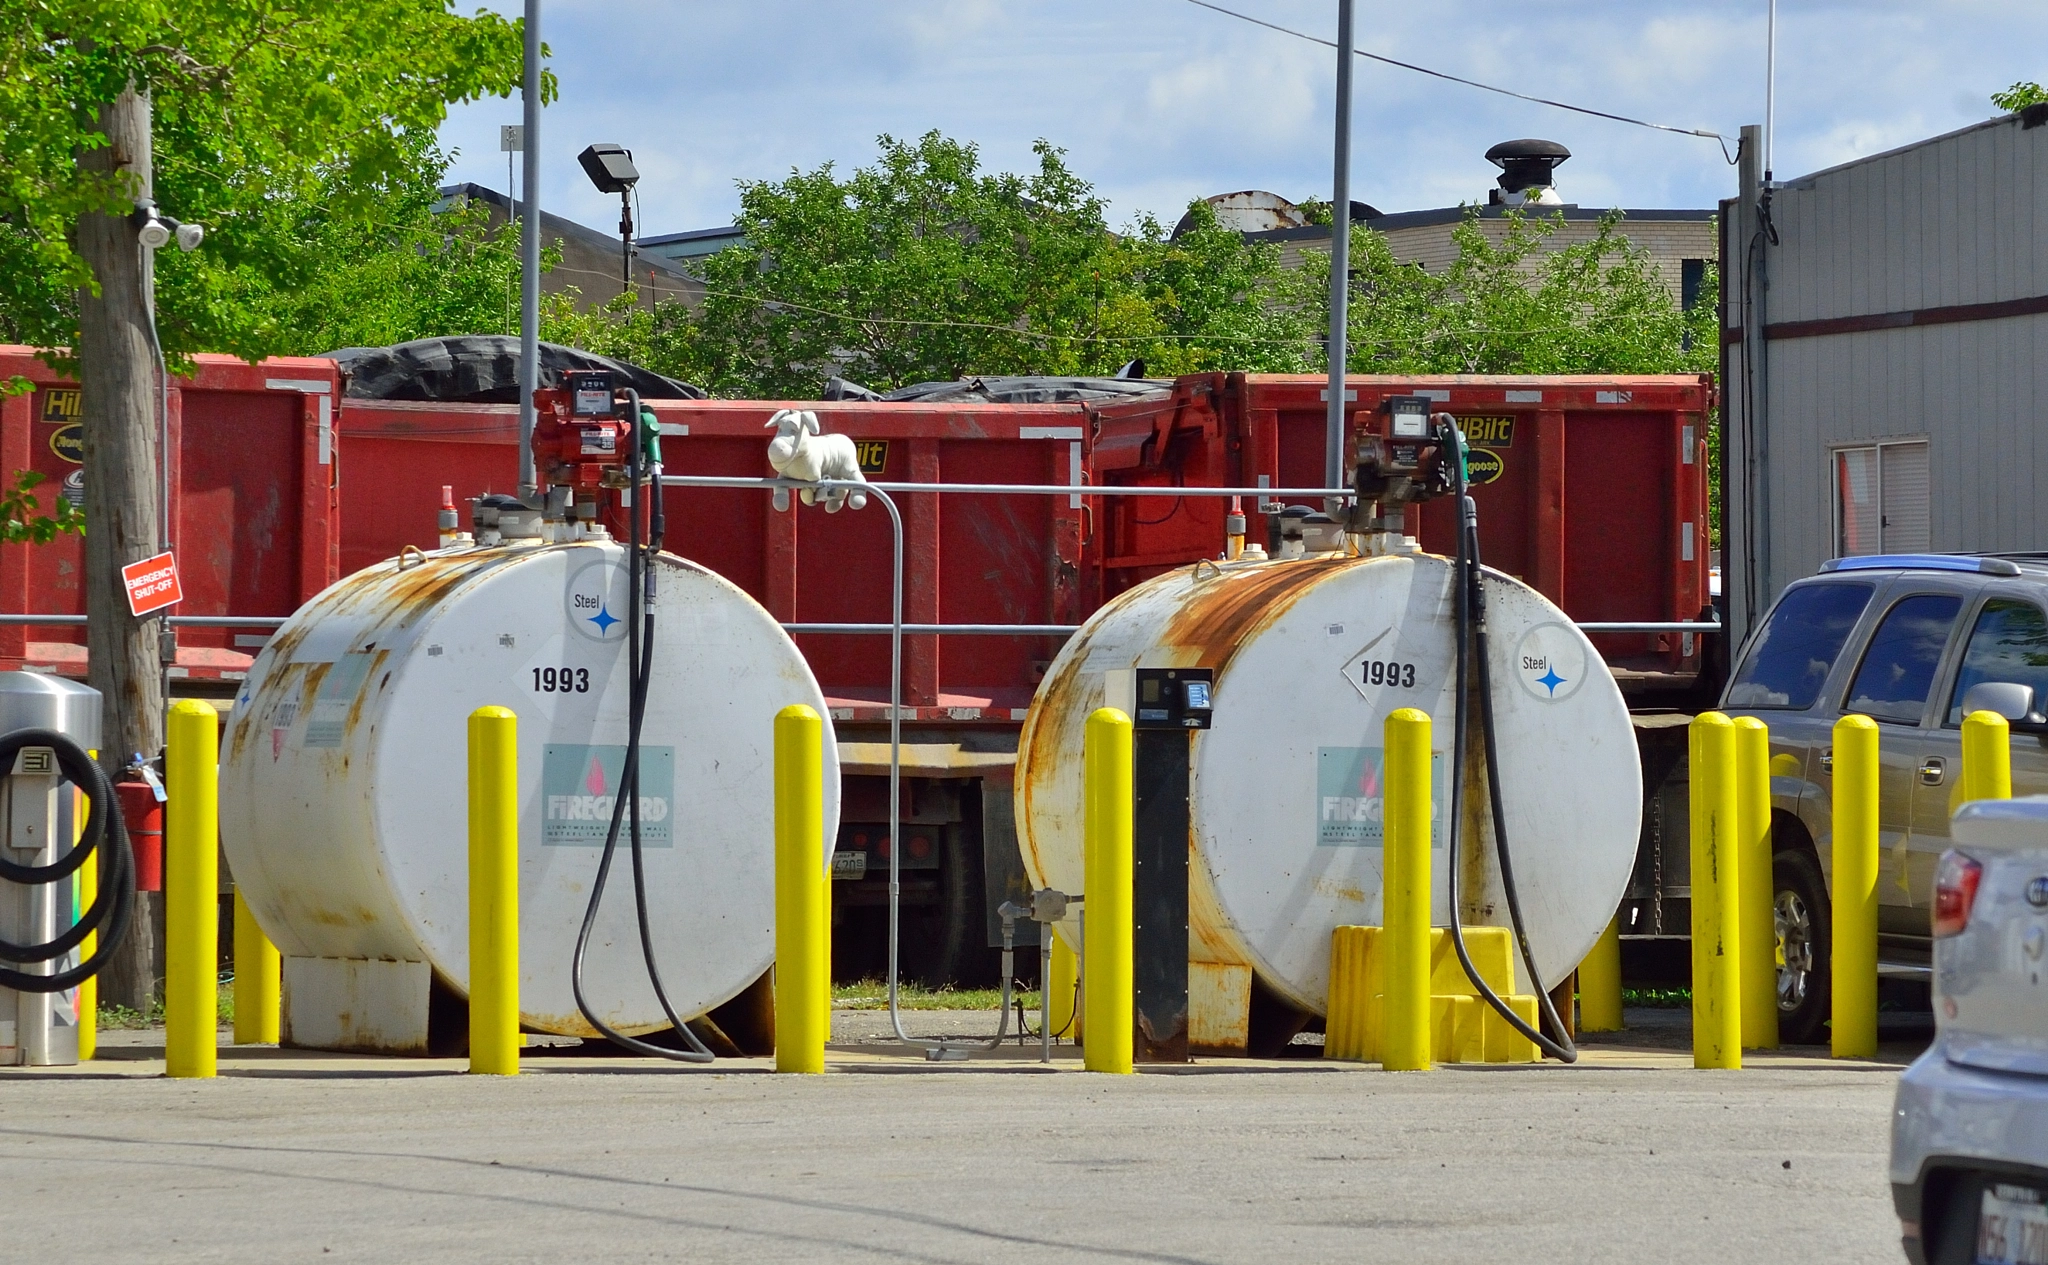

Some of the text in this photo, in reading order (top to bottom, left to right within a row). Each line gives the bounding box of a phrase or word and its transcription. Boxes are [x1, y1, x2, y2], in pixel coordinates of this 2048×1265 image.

[1457, 417, 1510, 440] ilBilt
[1467, 461, 1499, 475] goose
[127, 566, 175, 589] EMERGENCY
[134, 578, 173, 600] SHUT-OFF
[574, 594, 600, 609] Steel
[1523, 655, 1547, 670] Steel
[532, 667, 590, 693] 1993
[1361, 660, 1415, 688] 1993
